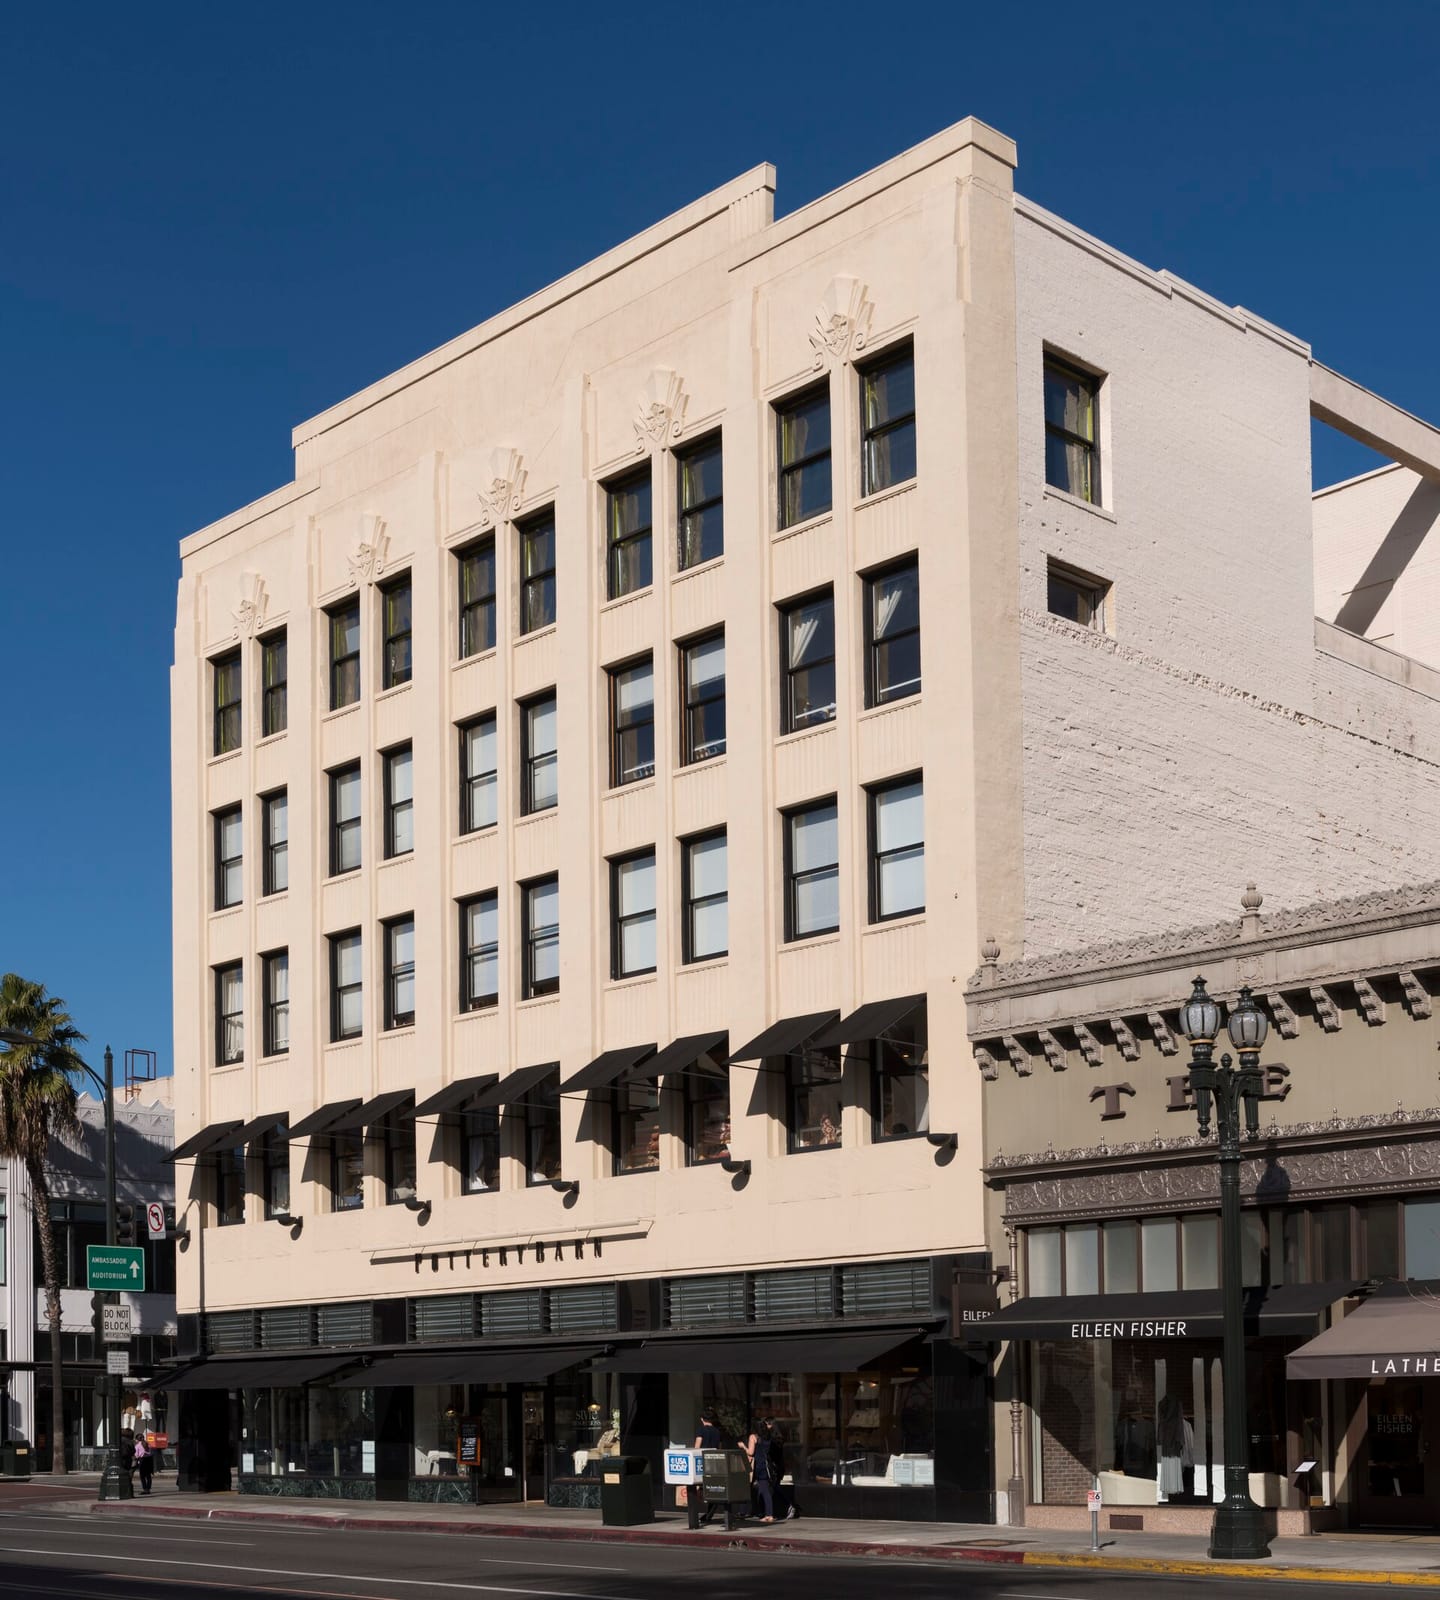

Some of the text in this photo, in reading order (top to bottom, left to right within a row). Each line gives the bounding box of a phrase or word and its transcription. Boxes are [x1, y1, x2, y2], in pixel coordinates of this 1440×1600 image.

[91, 1256, 127, 1264] AMBASSADOR
[104, 1309, 129, 1318] DO NOT
[104, 1321, 129, 1330] BLOCK
[1071, 1321, 1187, 1338] EILEEN FISHER
[1371, 1358, 1440, 1374] LATHE
[1376, 1414, 1413, 1424] EILEEN
[1377, 1424, 1413, 1433] FISHER
